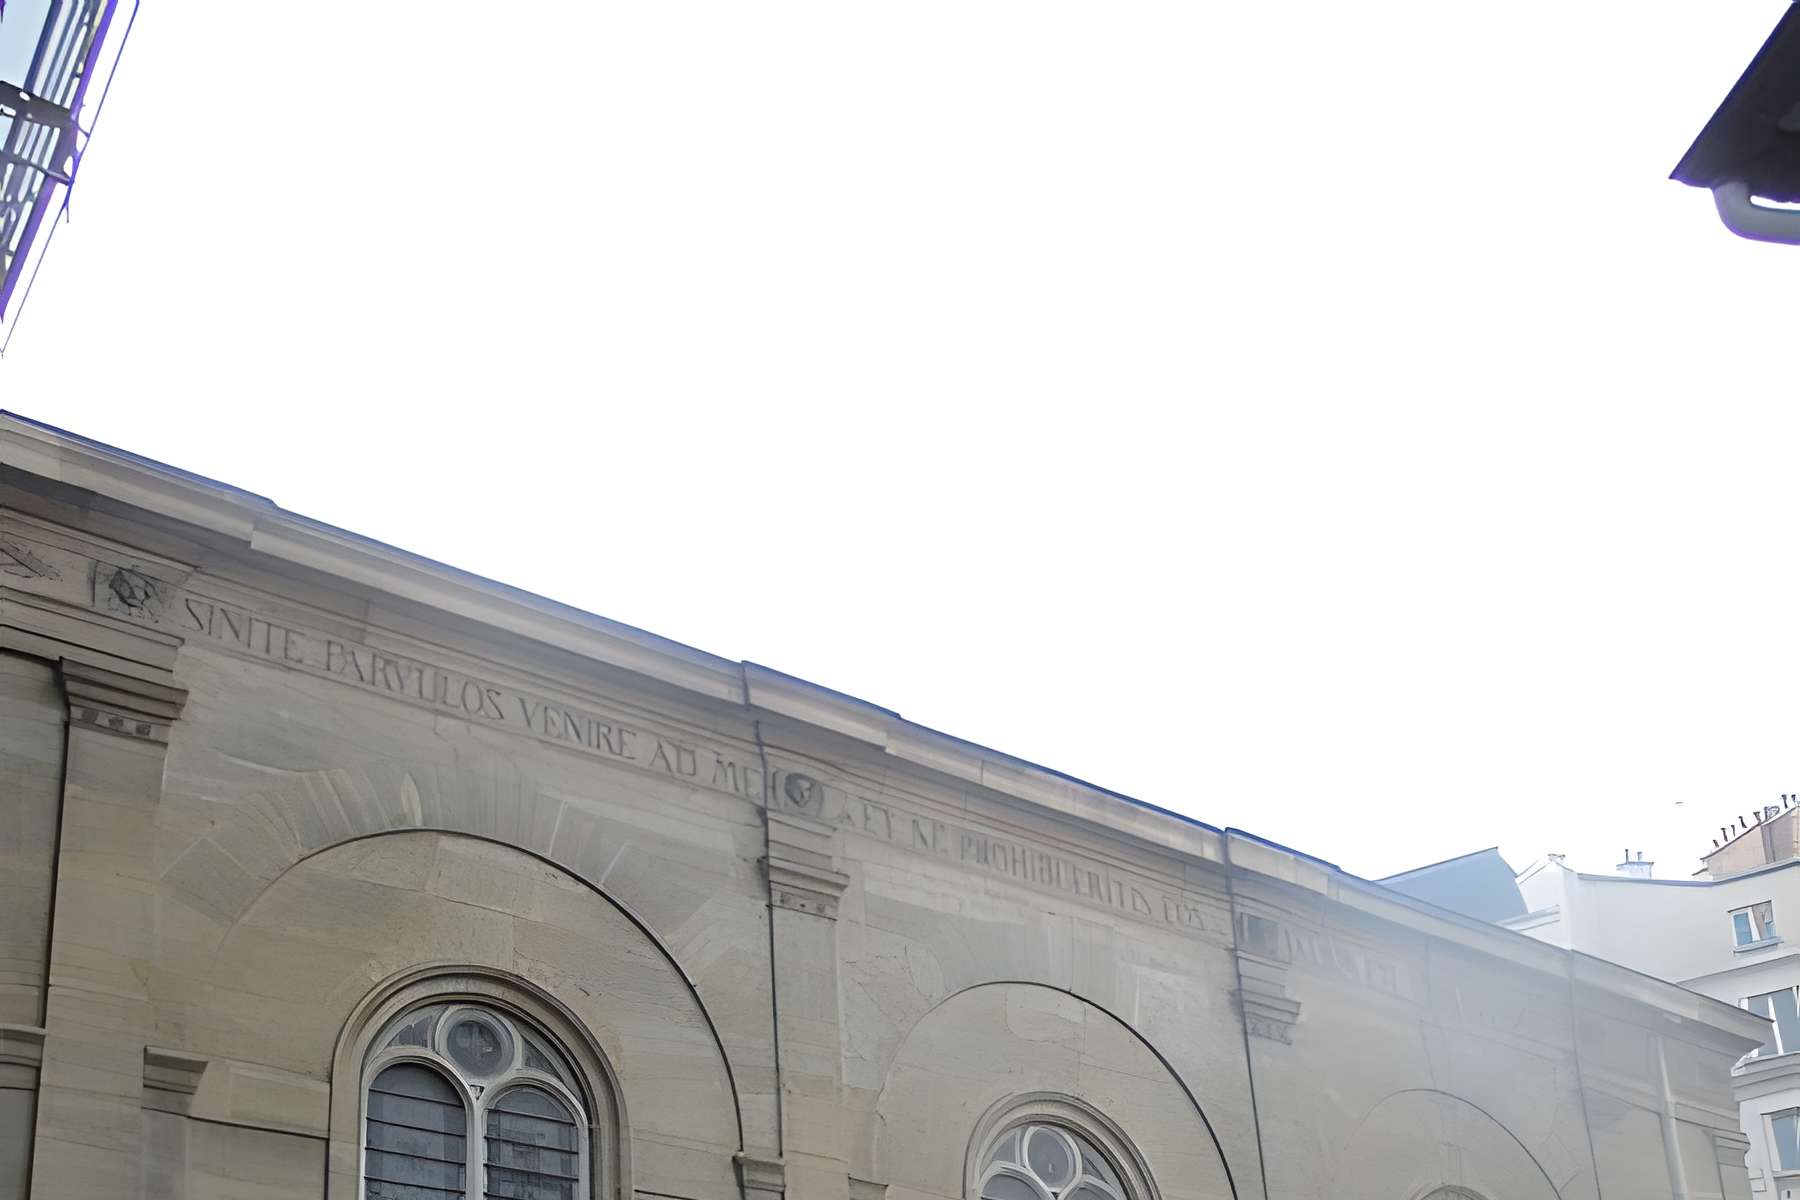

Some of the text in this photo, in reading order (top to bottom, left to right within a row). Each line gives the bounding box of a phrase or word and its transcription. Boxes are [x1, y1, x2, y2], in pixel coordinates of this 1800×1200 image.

[181, 598, 304, 663] SINITE
[325, 639, 504, 720] PARVULOS
[517, 697, 637, 760] VENIRE
[650, 735, 697, 776] AD
